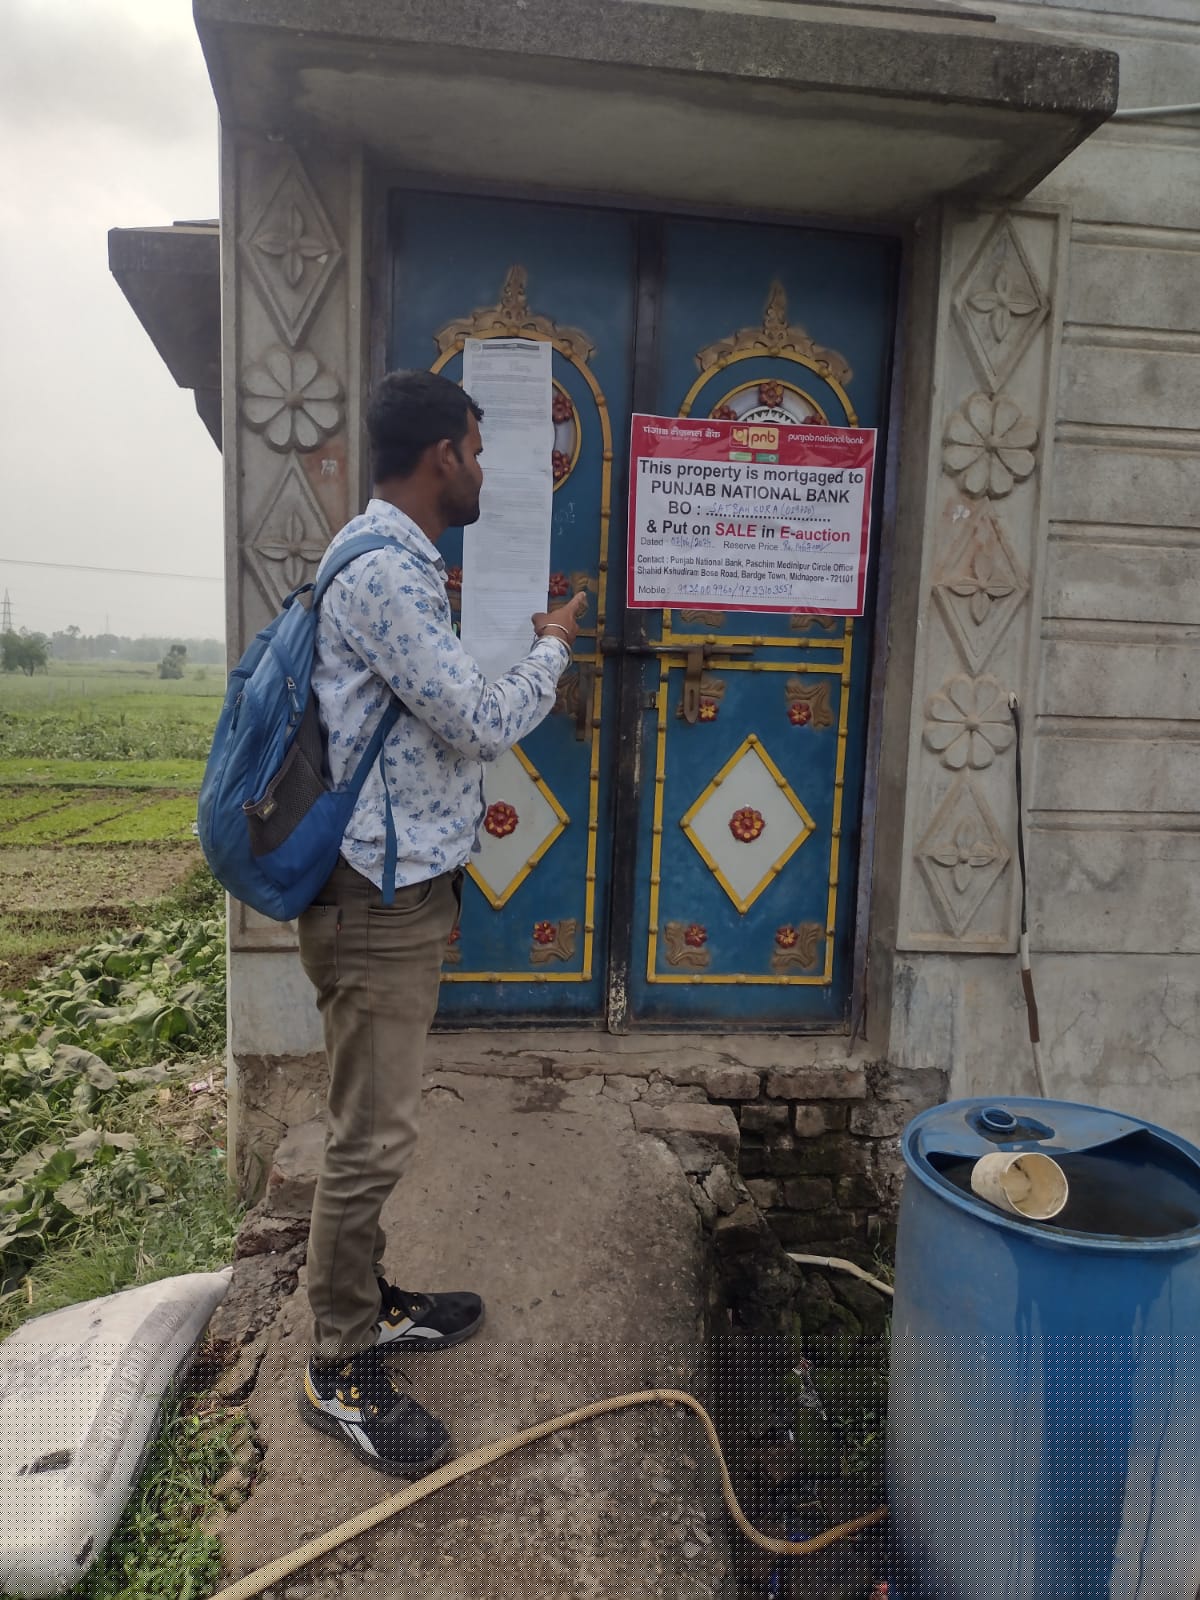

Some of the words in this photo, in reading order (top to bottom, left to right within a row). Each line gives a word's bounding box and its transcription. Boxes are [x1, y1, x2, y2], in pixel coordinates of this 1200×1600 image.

[752, 430, 776, 445] pnb
[788, 433, 814, 443] punjab
[814, 434, 845, 444] national
[845, 434, 864, 444] bank
[640, 460, 672, 474] This
[677, 464, 742, 482] property
[746, 466, 758, 480] is
[764, 468, 844, 486] mortgaged
[848, 472, 864, 484] to
[651, 480, 716, 497] PUNJAB
[721, 484, 802, 501] NATIONAL
[806, 488, 850, 504] BANK
[668, 501, 692, 515] BO
[646, 520, 656, 533] &
[662, 520, 688, 534] Put
[692, 524, 710, 535] on
[716, 522, 758, 538] SALE
[762, 524, 775, 538] in
[780, 526, 850, 542] E-auction
[640, 536, 664, 546] Dated
[724, 541, 756, 550] Reserve
[758, 543, 778, 551] Price
[637, 554, 664, 564] Contact
[670, 556, 694, 566] Punjab
[696, 558, 722, 566] National
[746, 560, 774, 568] Paschim
[776, 561, 810, 572] Medinipur
[812, 562, 832, 572] Circle
[834, 564, 854, 572] Office
[637, 566, 662, 575] Shahid
[664, 568, 699, 576] Kshudiram
[701, 569, 718, 577] Bose
[720, 570, 740, 579] Road,
[742, 570, 766, 580] Bardge
[790, 573, 824, 582] Midnapore
[638, 586, 666, 594] Mobile
